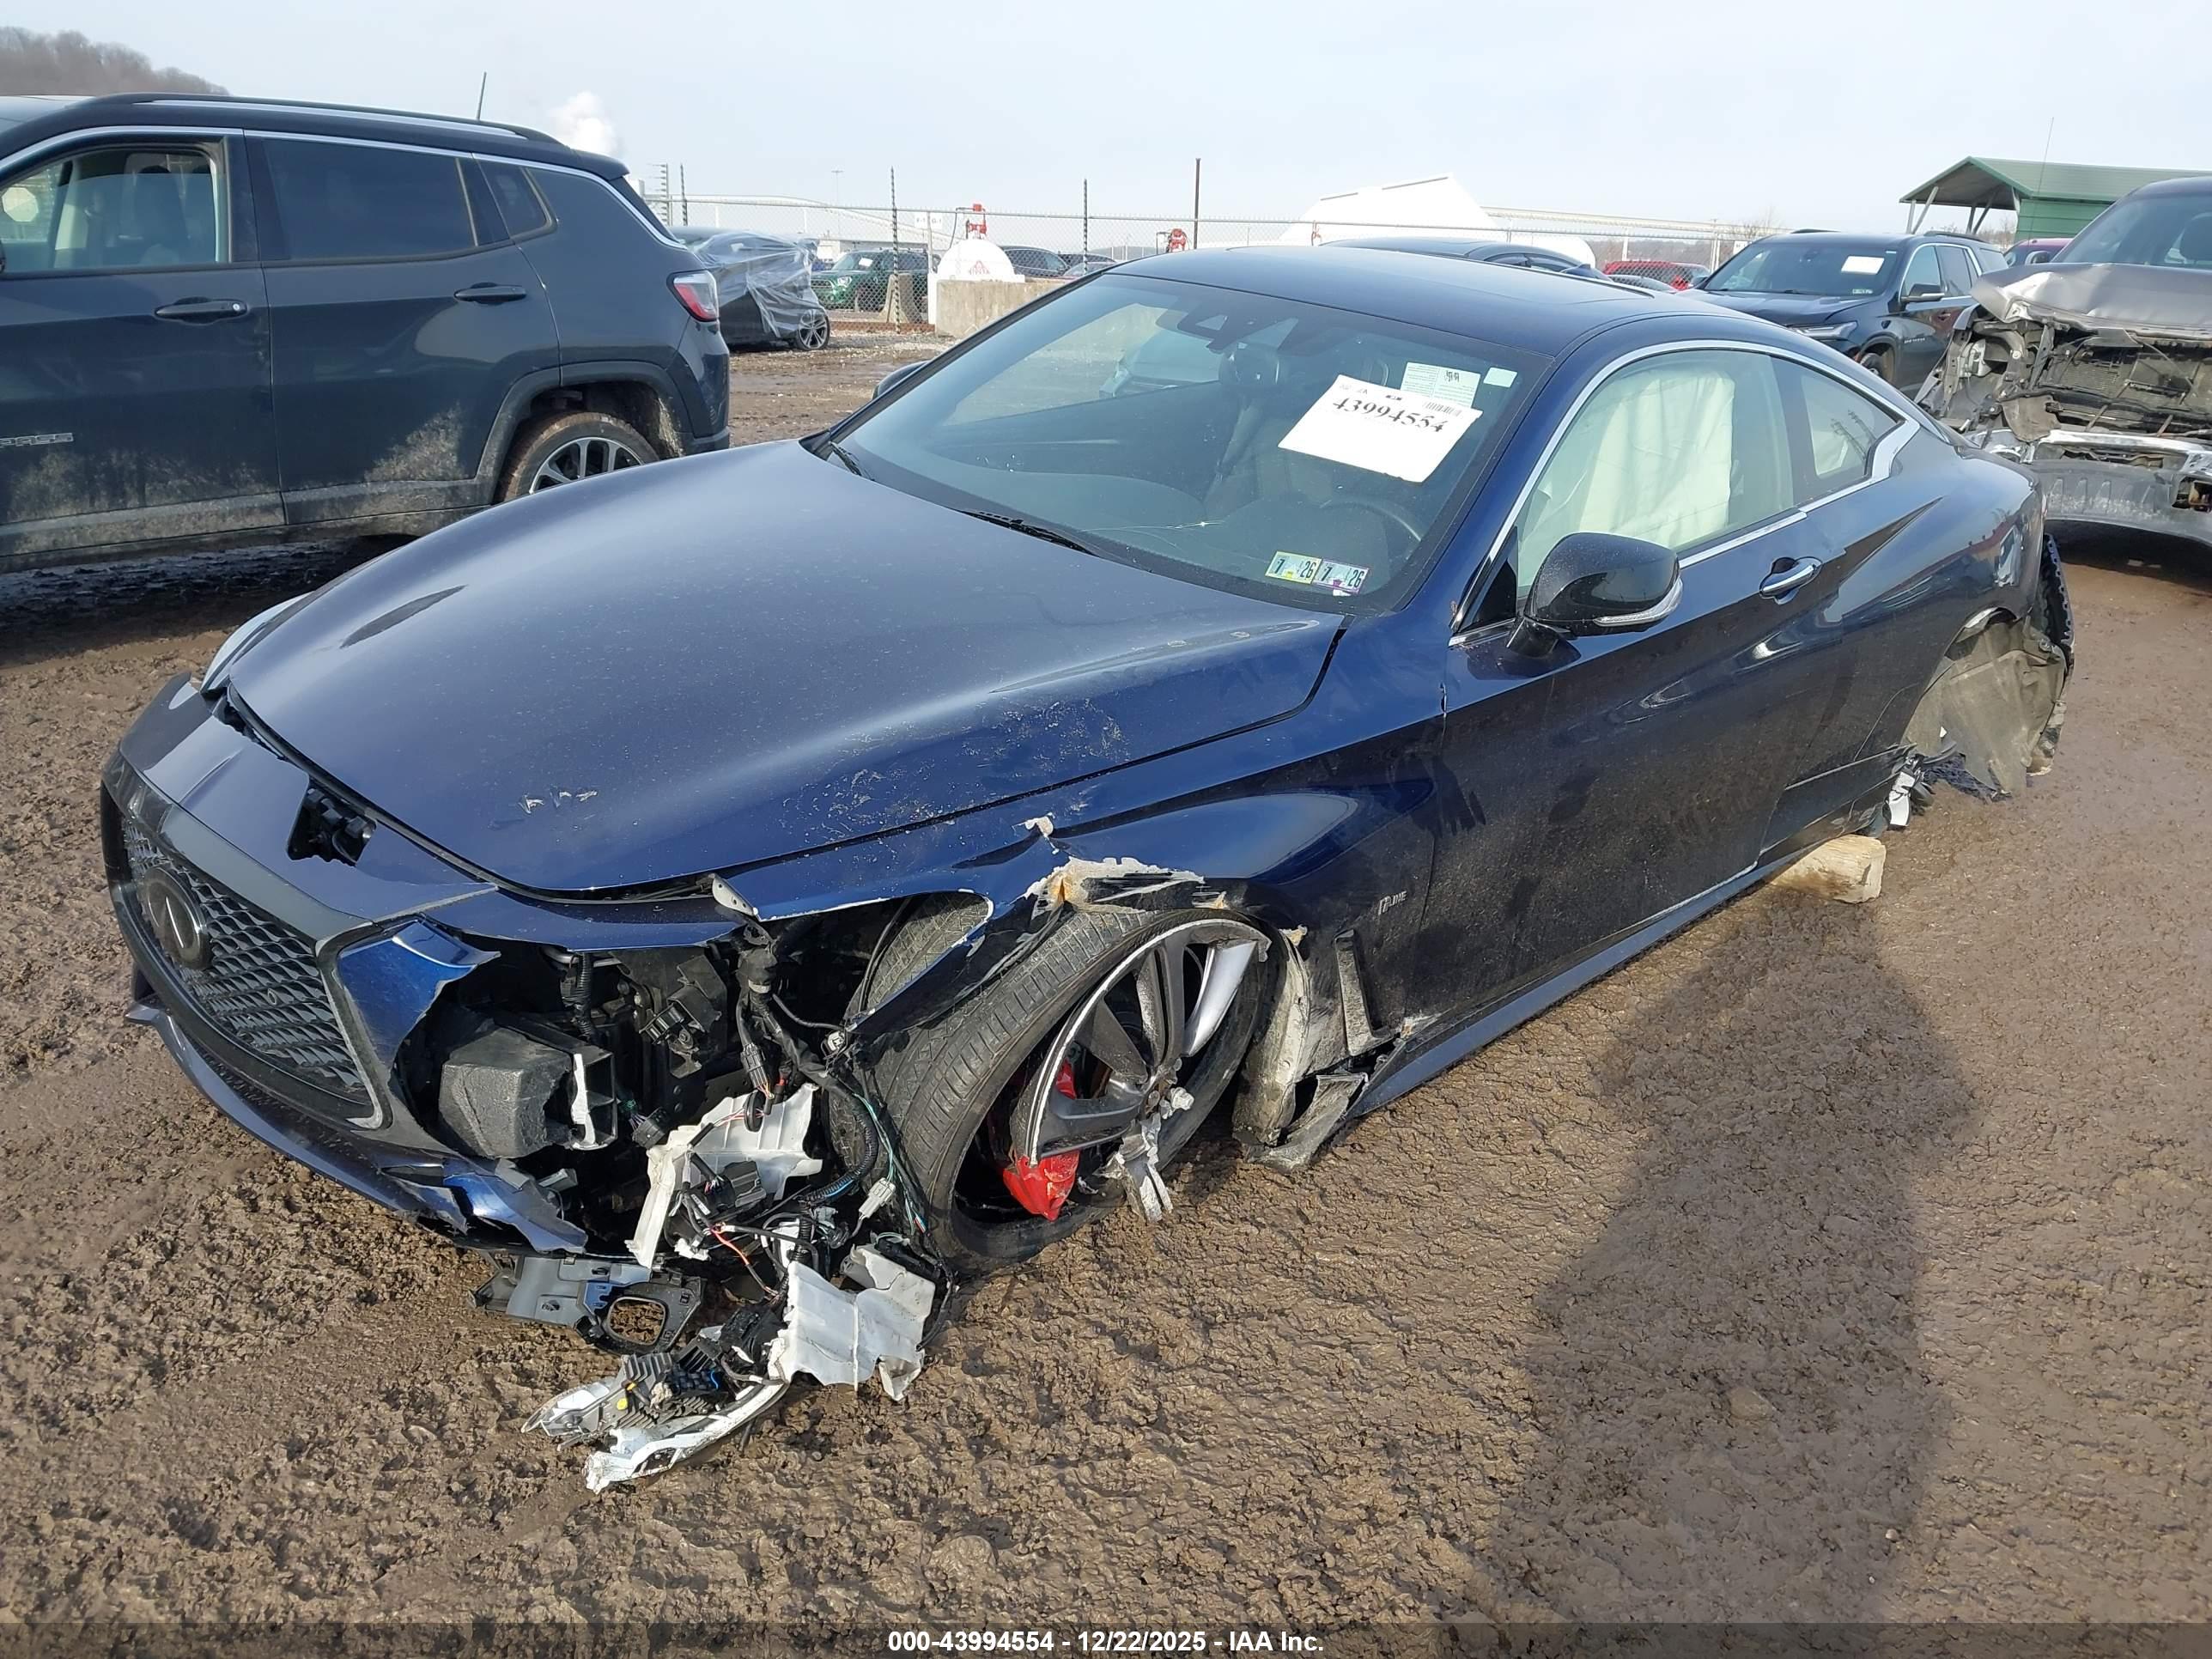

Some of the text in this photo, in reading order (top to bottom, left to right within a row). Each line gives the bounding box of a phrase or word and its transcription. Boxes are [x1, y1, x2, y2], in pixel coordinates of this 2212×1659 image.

[1333, 398, 1448, 433] 43994554
[1300, 561, 1316, 579] 26
[1347, 569, 1365, 588] 26
